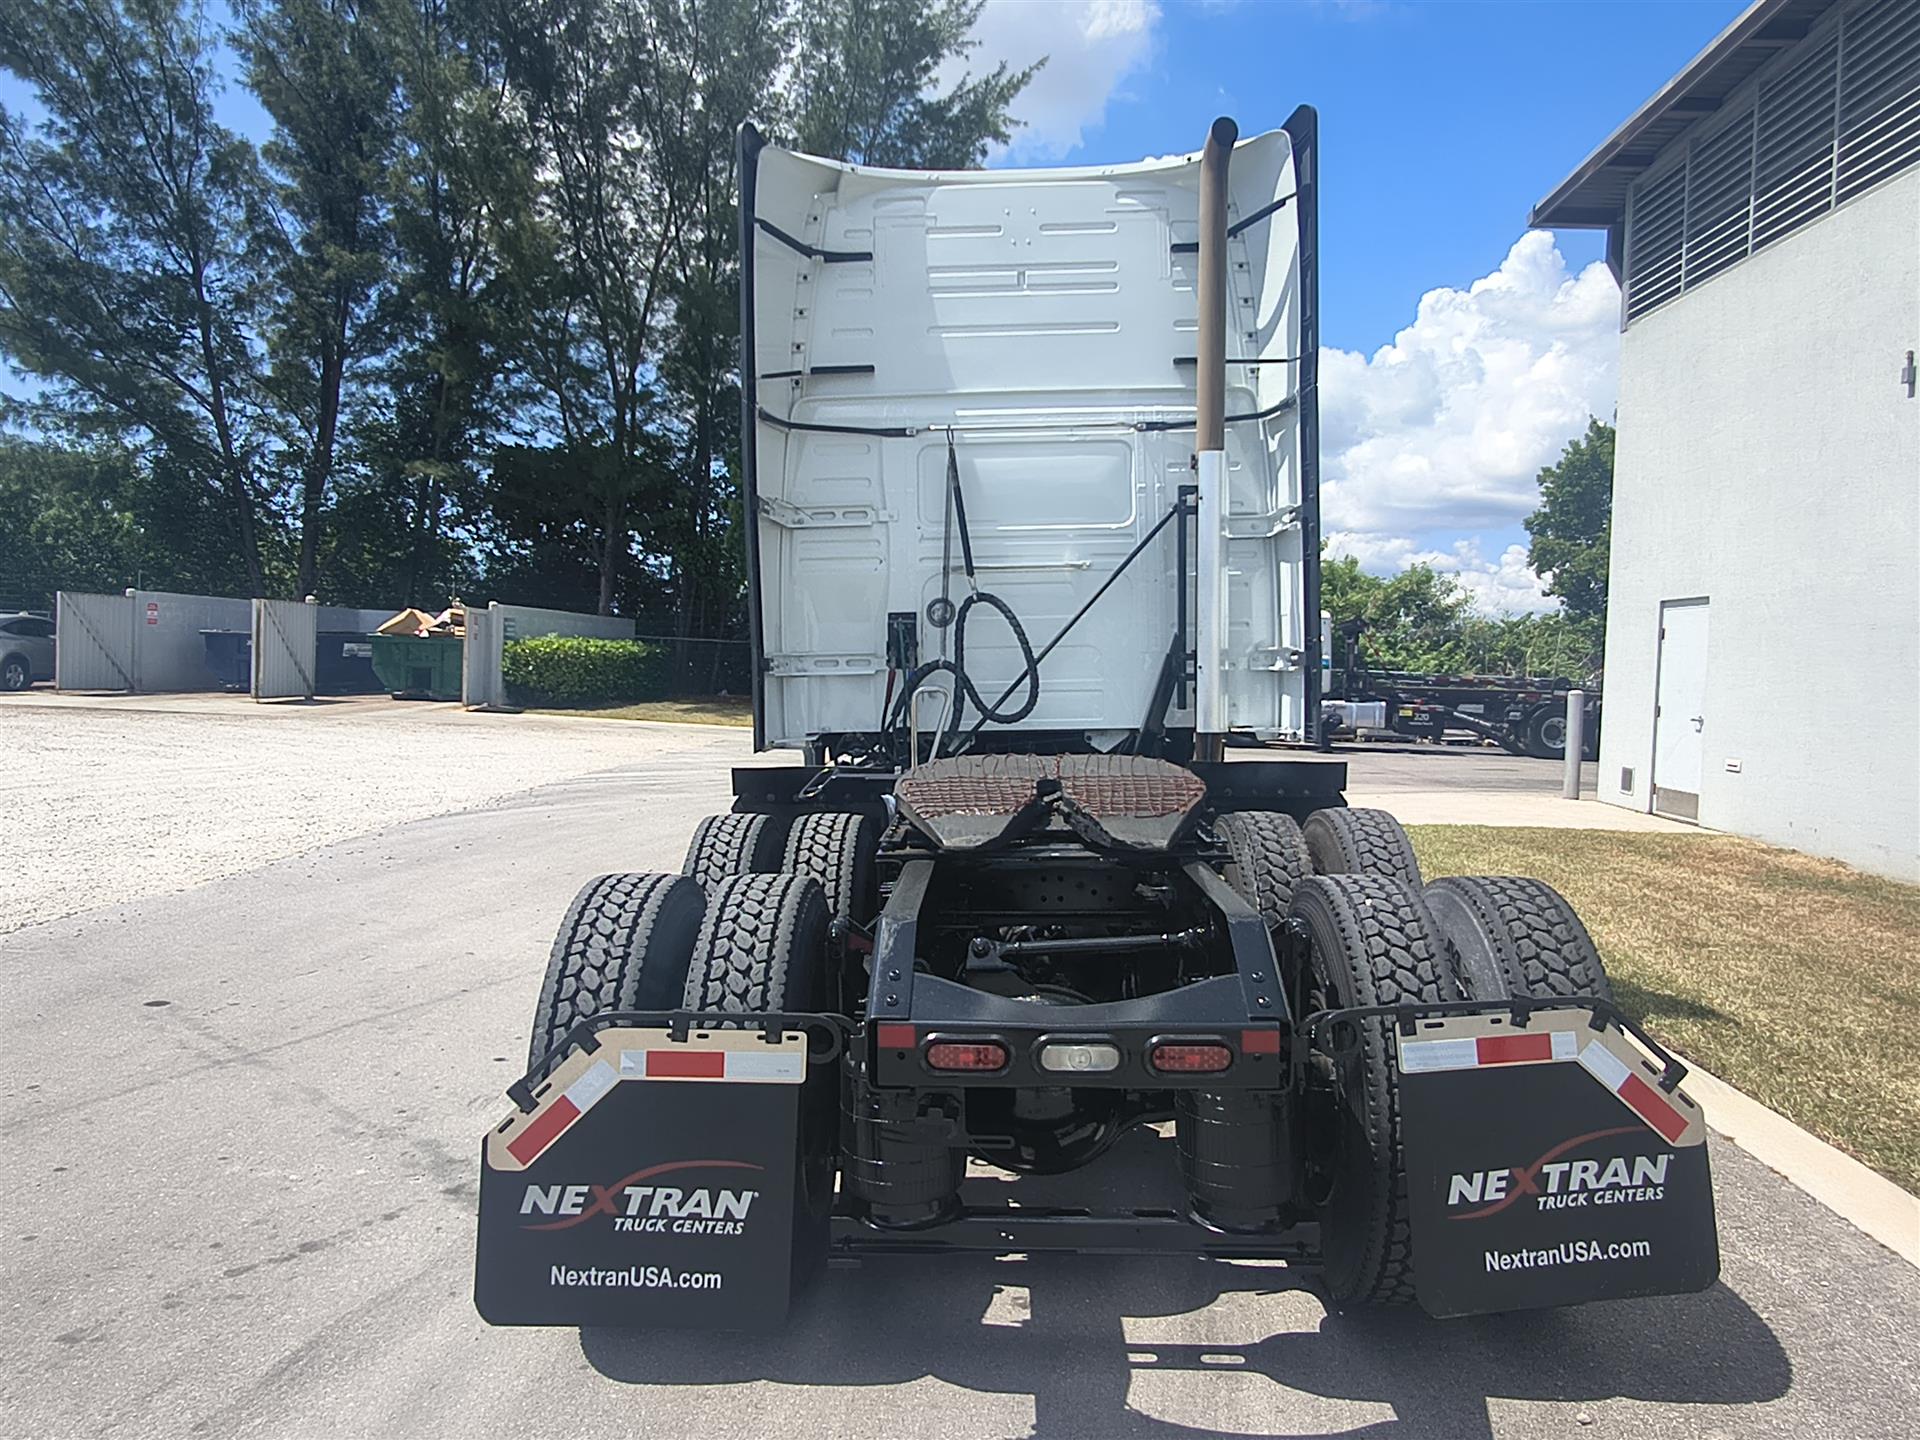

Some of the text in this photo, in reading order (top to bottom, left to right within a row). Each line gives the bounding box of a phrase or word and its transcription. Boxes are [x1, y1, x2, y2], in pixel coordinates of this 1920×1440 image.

[1448, 1154, 1668, 1205] NEXTRAN
[520, 1185, 754, 1219] NEXTRAN
[1537, 1187, 1664, 1211] TRUCK CENTERS
[614, 1219, 744, 1235] TRUCK CENTERS
[1485, 1240, 1650, 1272] NextranUSA.com
[551, 1265, 721, 1289] NextranUSA.com
